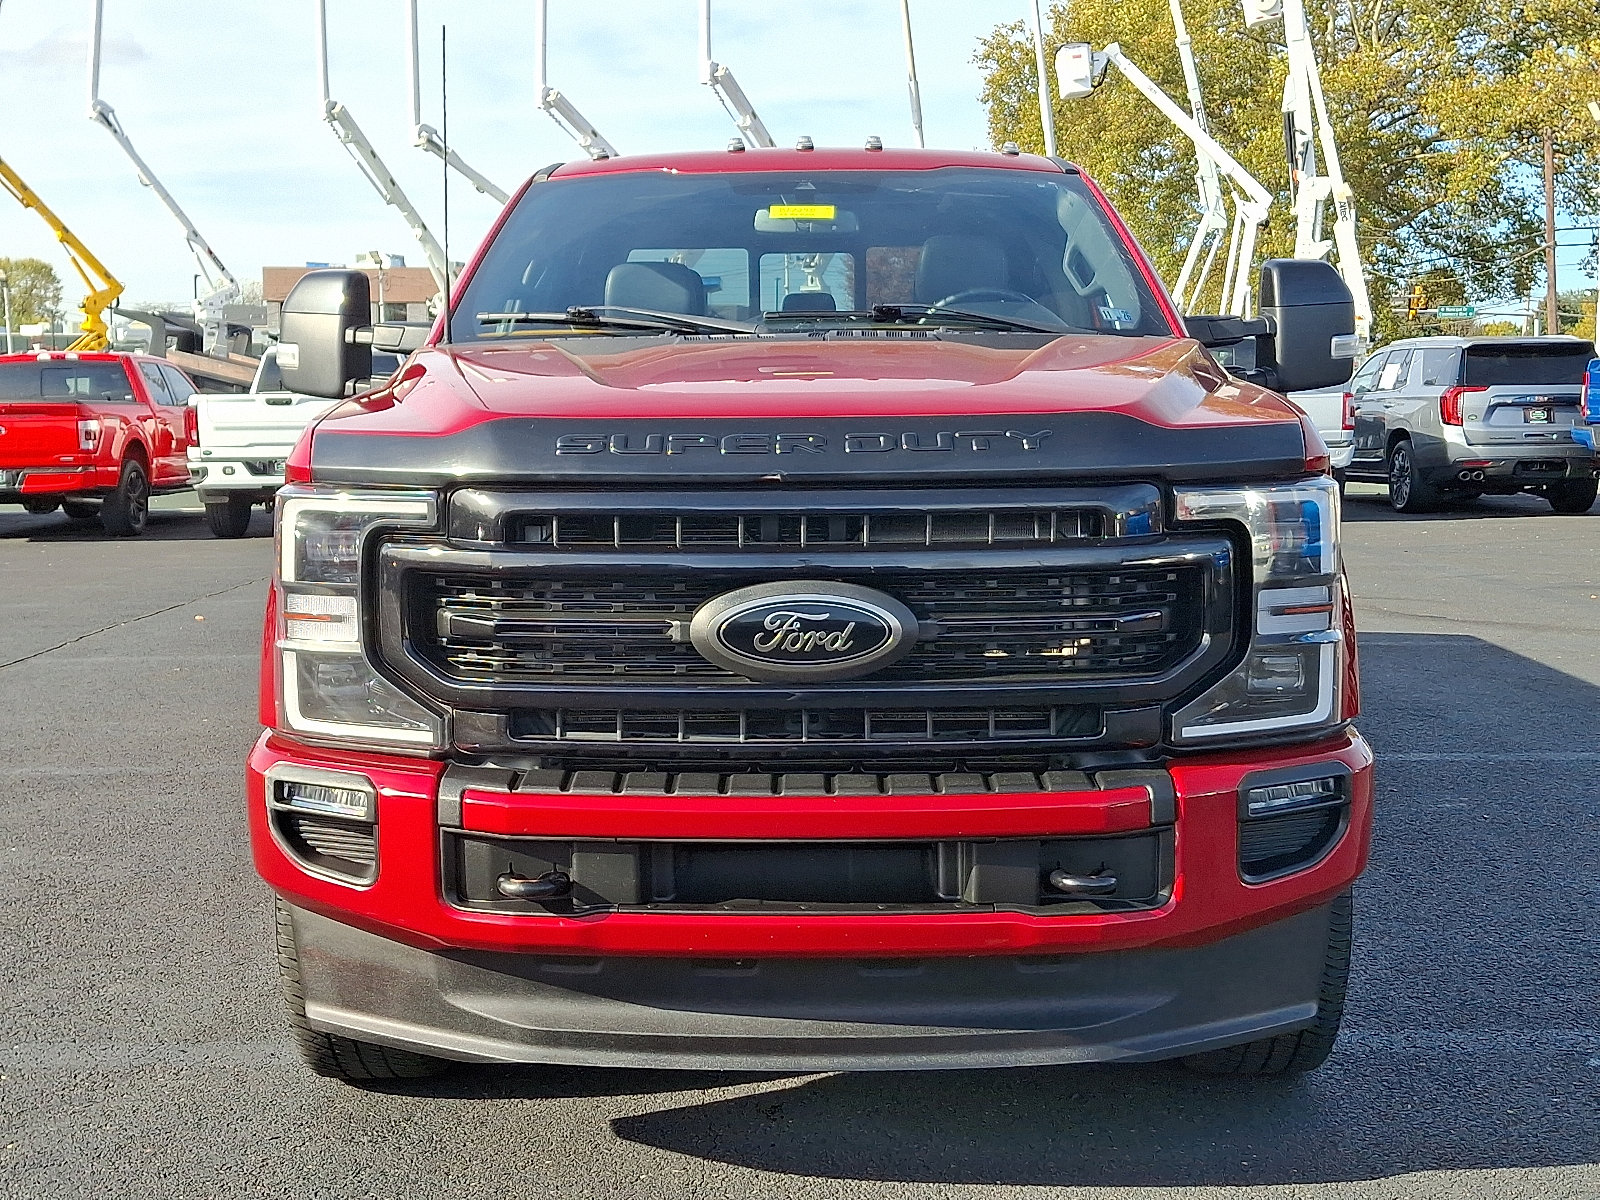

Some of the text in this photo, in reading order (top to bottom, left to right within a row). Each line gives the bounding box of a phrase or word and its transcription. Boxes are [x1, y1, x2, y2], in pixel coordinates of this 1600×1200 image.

[555, 430, 1052, 455] SUPER DUTY
[754, 611, 855, 652] Ford
